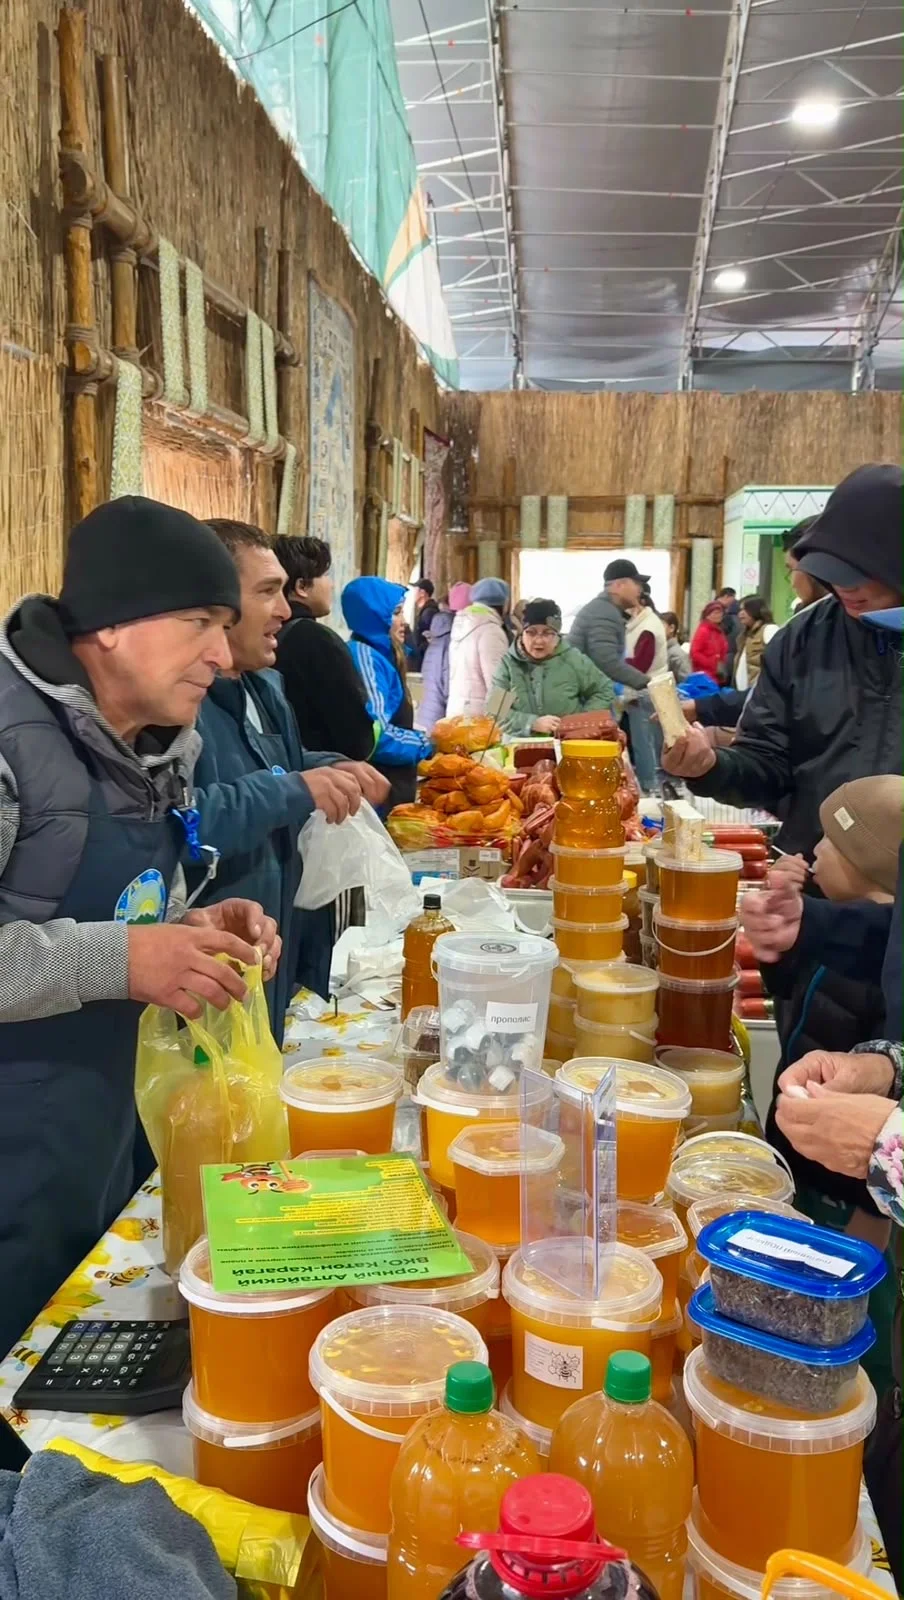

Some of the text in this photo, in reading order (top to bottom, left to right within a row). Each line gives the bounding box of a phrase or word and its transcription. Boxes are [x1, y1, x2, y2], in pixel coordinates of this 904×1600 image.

[232, 1261, 378, 1276] Катон-Карагай
[238, 1267, 429, 1287] Горный Алтайский
